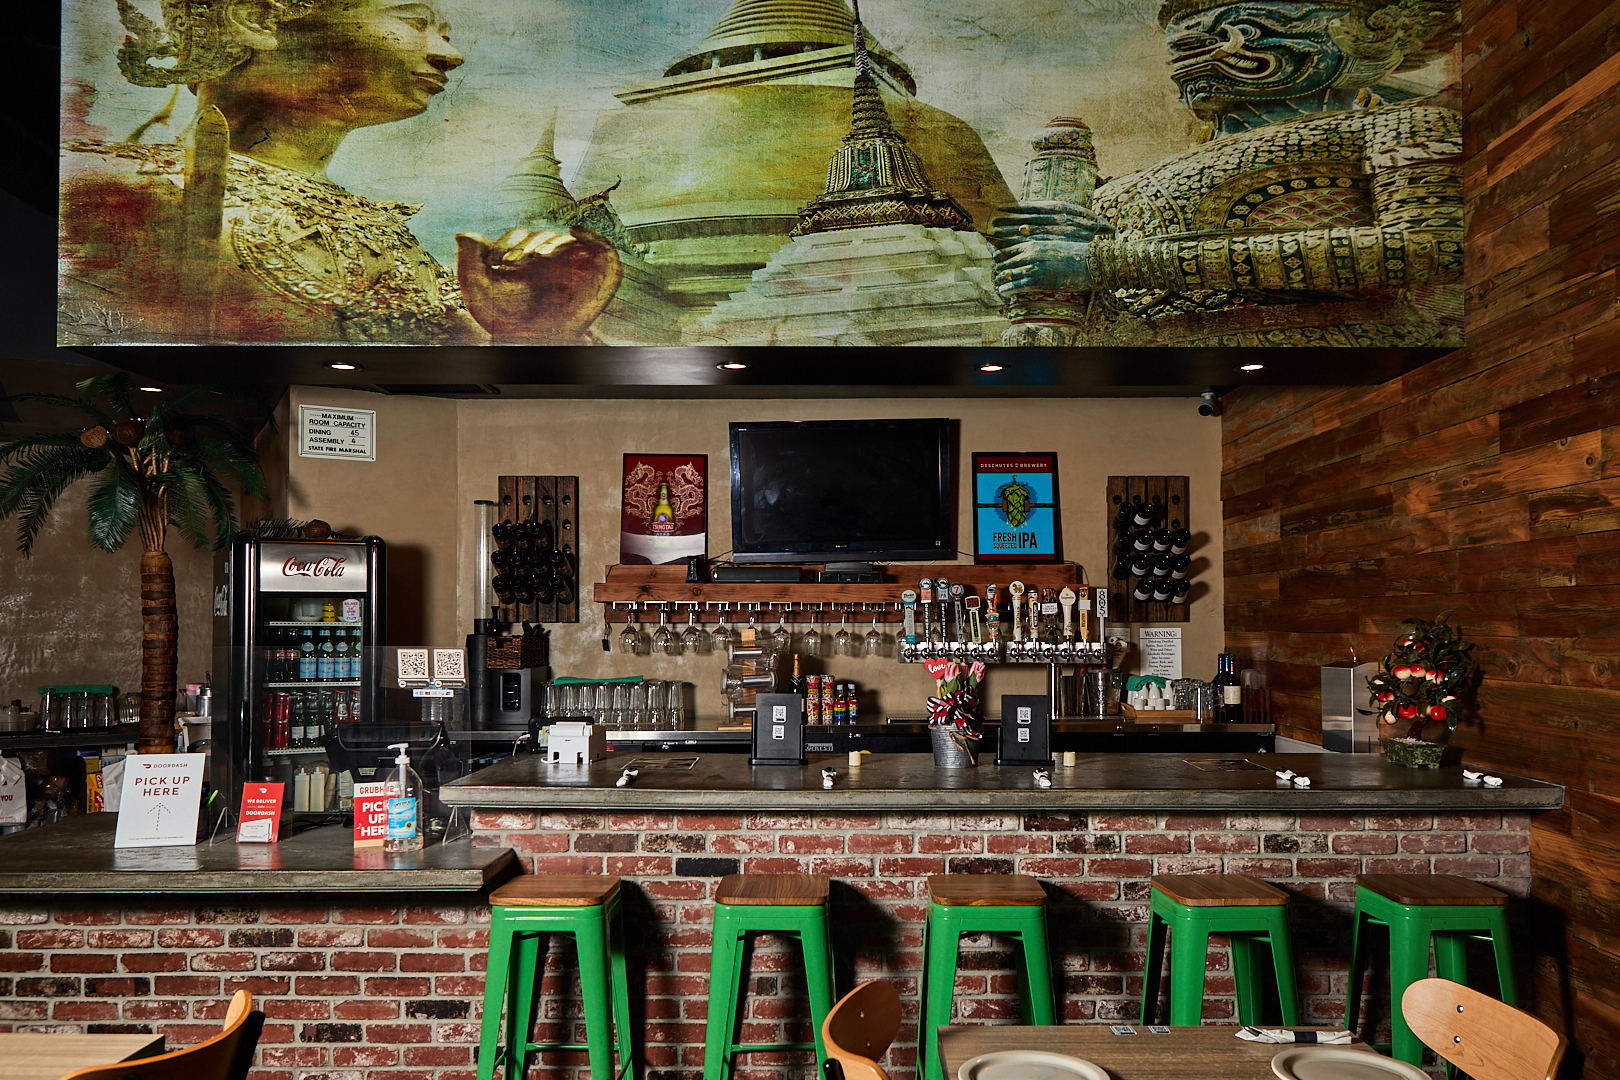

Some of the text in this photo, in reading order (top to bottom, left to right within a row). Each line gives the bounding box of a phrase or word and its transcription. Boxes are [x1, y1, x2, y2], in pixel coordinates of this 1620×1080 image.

[993, 532, 1037, 548] FRESH IPA
[928, 664, 945, 673] love
[135, 777, 167, 786] PICK
[143, 788, 179, 796] HERE
[368, 814, 384, 824] UP
[361, 826, 388, 836] HER
